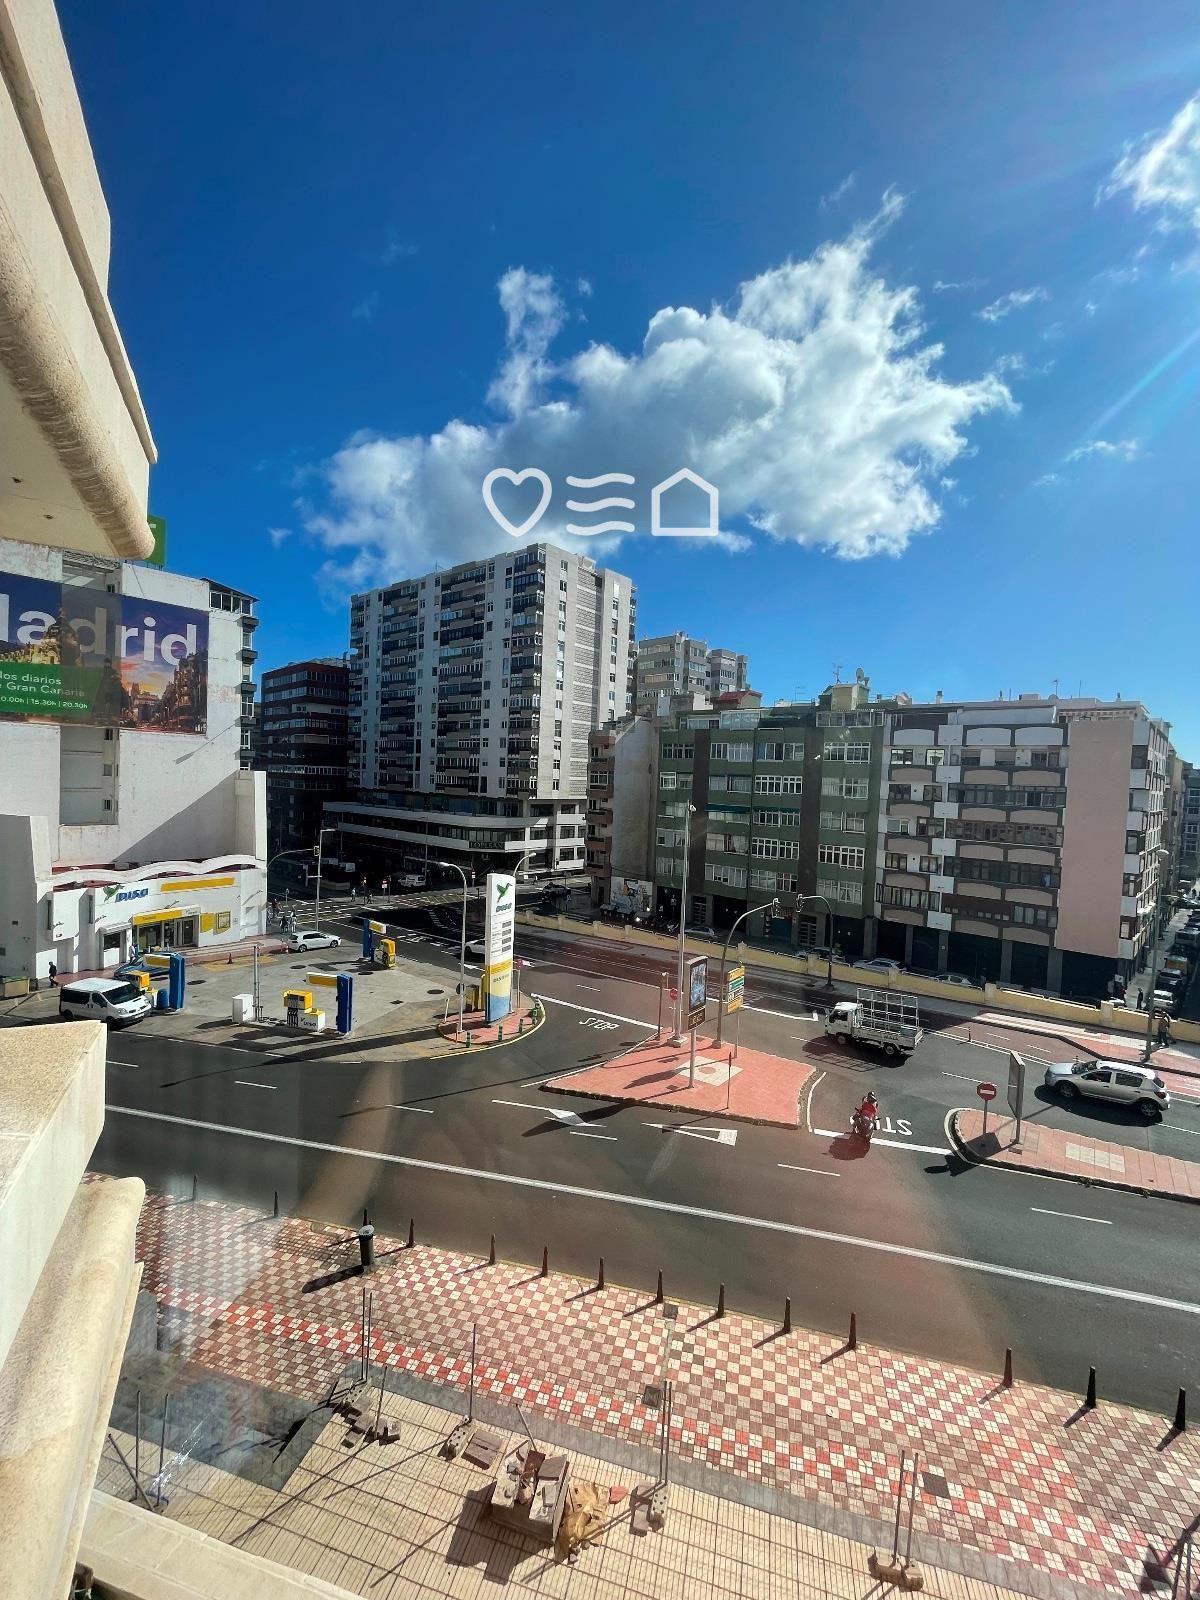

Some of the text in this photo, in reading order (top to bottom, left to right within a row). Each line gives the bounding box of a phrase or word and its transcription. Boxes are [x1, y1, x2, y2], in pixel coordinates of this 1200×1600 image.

[0, 593, 197, 666] adrid
[22, 673, 62, 685] diarios
[6, 681, 36, 692] Gran
[40, 685, 85, 697] Canaria
[578, 1017, 620, 1031] STOP
